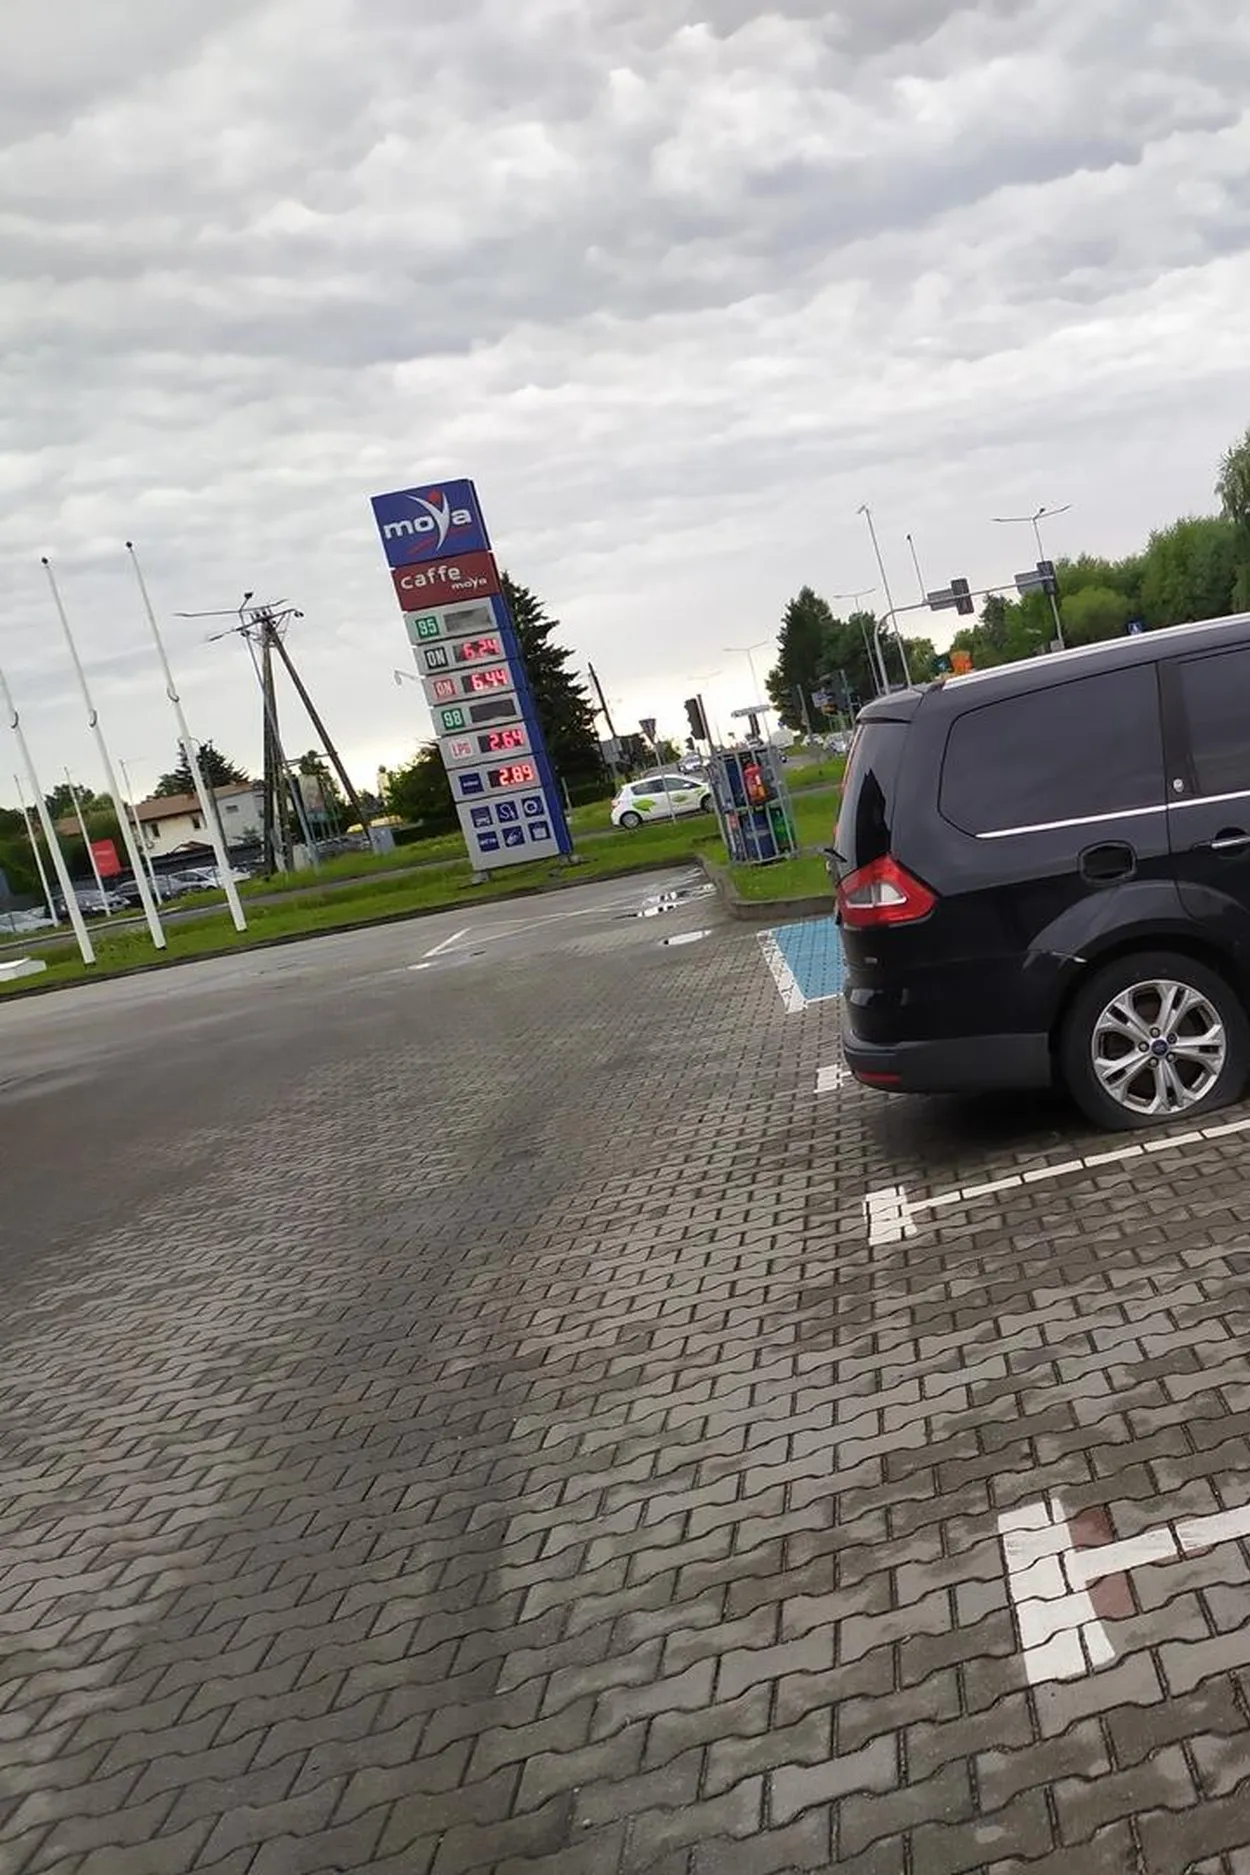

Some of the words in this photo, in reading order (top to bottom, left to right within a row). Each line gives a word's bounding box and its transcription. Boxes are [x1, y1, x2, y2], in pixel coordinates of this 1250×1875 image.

[401, 565, 461, 590] caffe
[418, 619, 437, 636] 95
[426, 646, 445, 666] ON
[444, 710, 462, 727] 98
[489, 730, 524, 751] 2.64
[500, 765, 534, 786] 2.89
